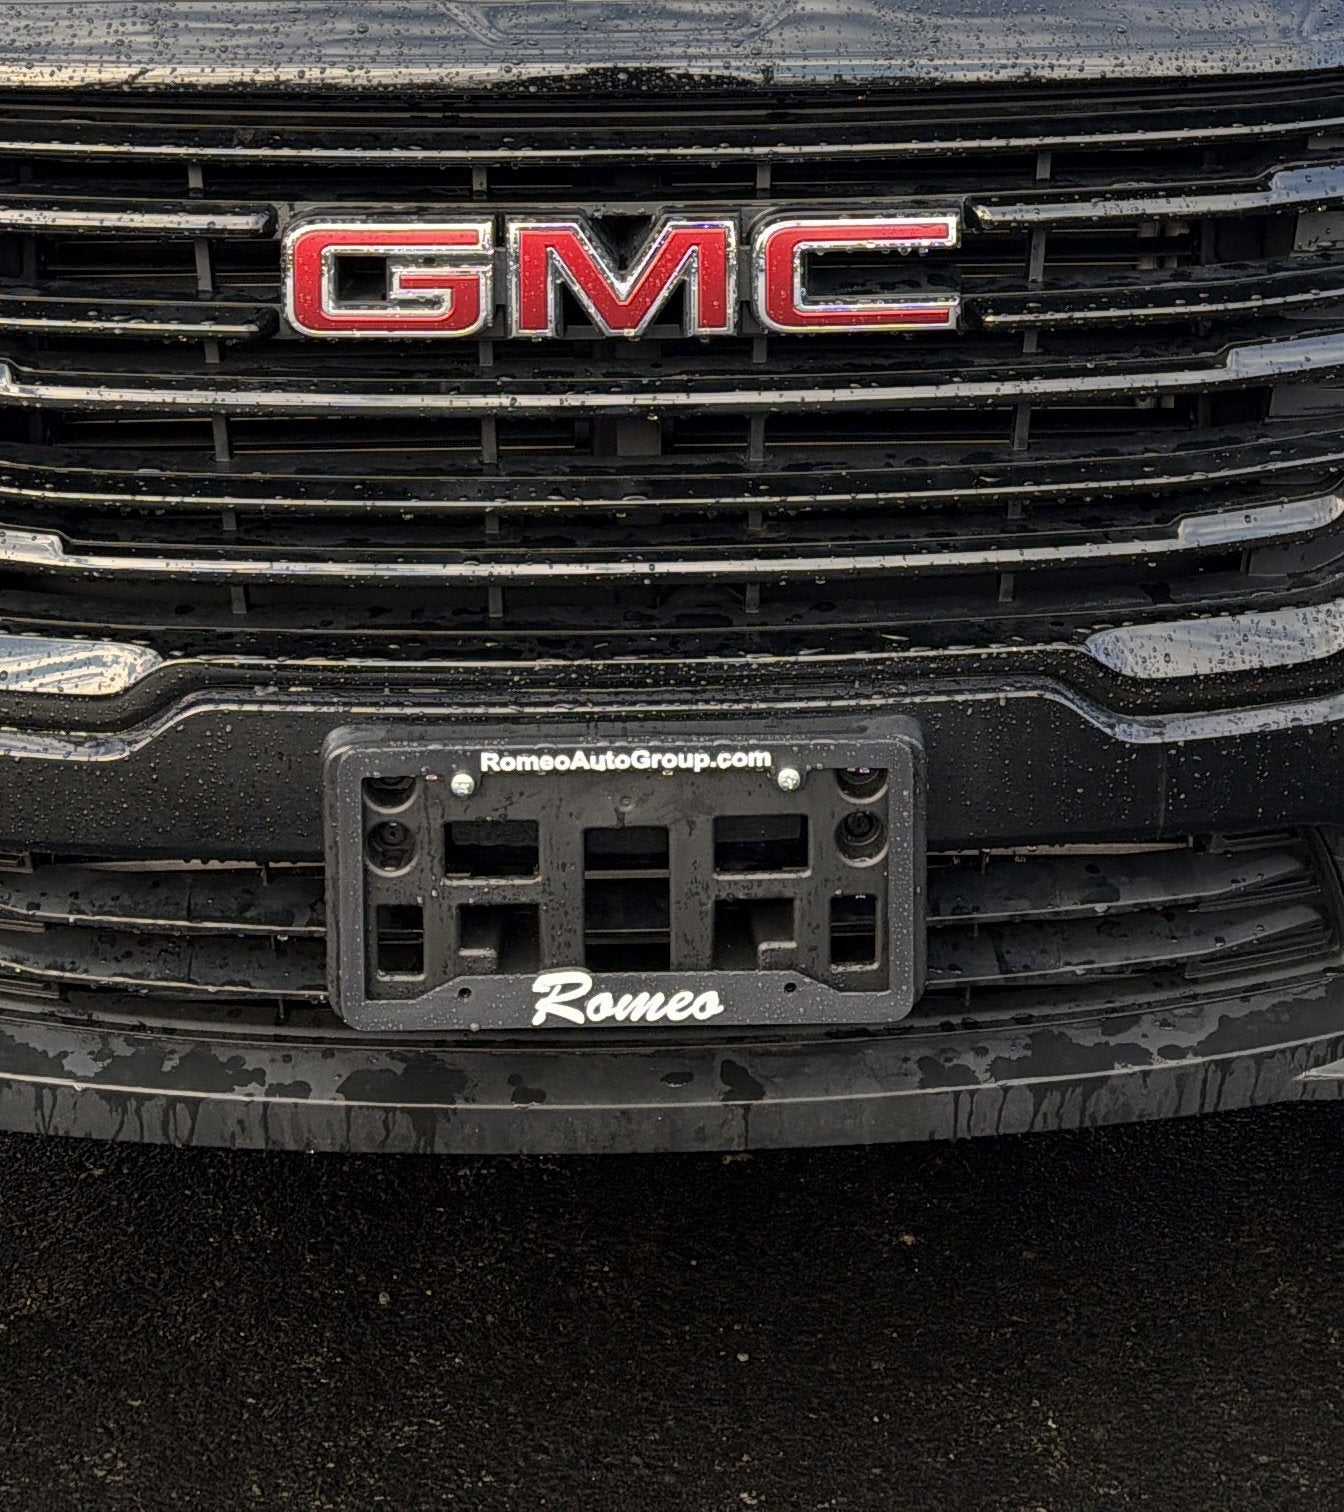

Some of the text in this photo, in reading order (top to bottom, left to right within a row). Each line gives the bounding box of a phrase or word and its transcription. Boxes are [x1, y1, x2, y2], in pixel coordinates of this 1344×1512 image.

[281, 215, 960, 338] GMC
[480, 749, 772, 773] RomeoAutoGroup.com
[531, 971, 725, 1027] Romeo
